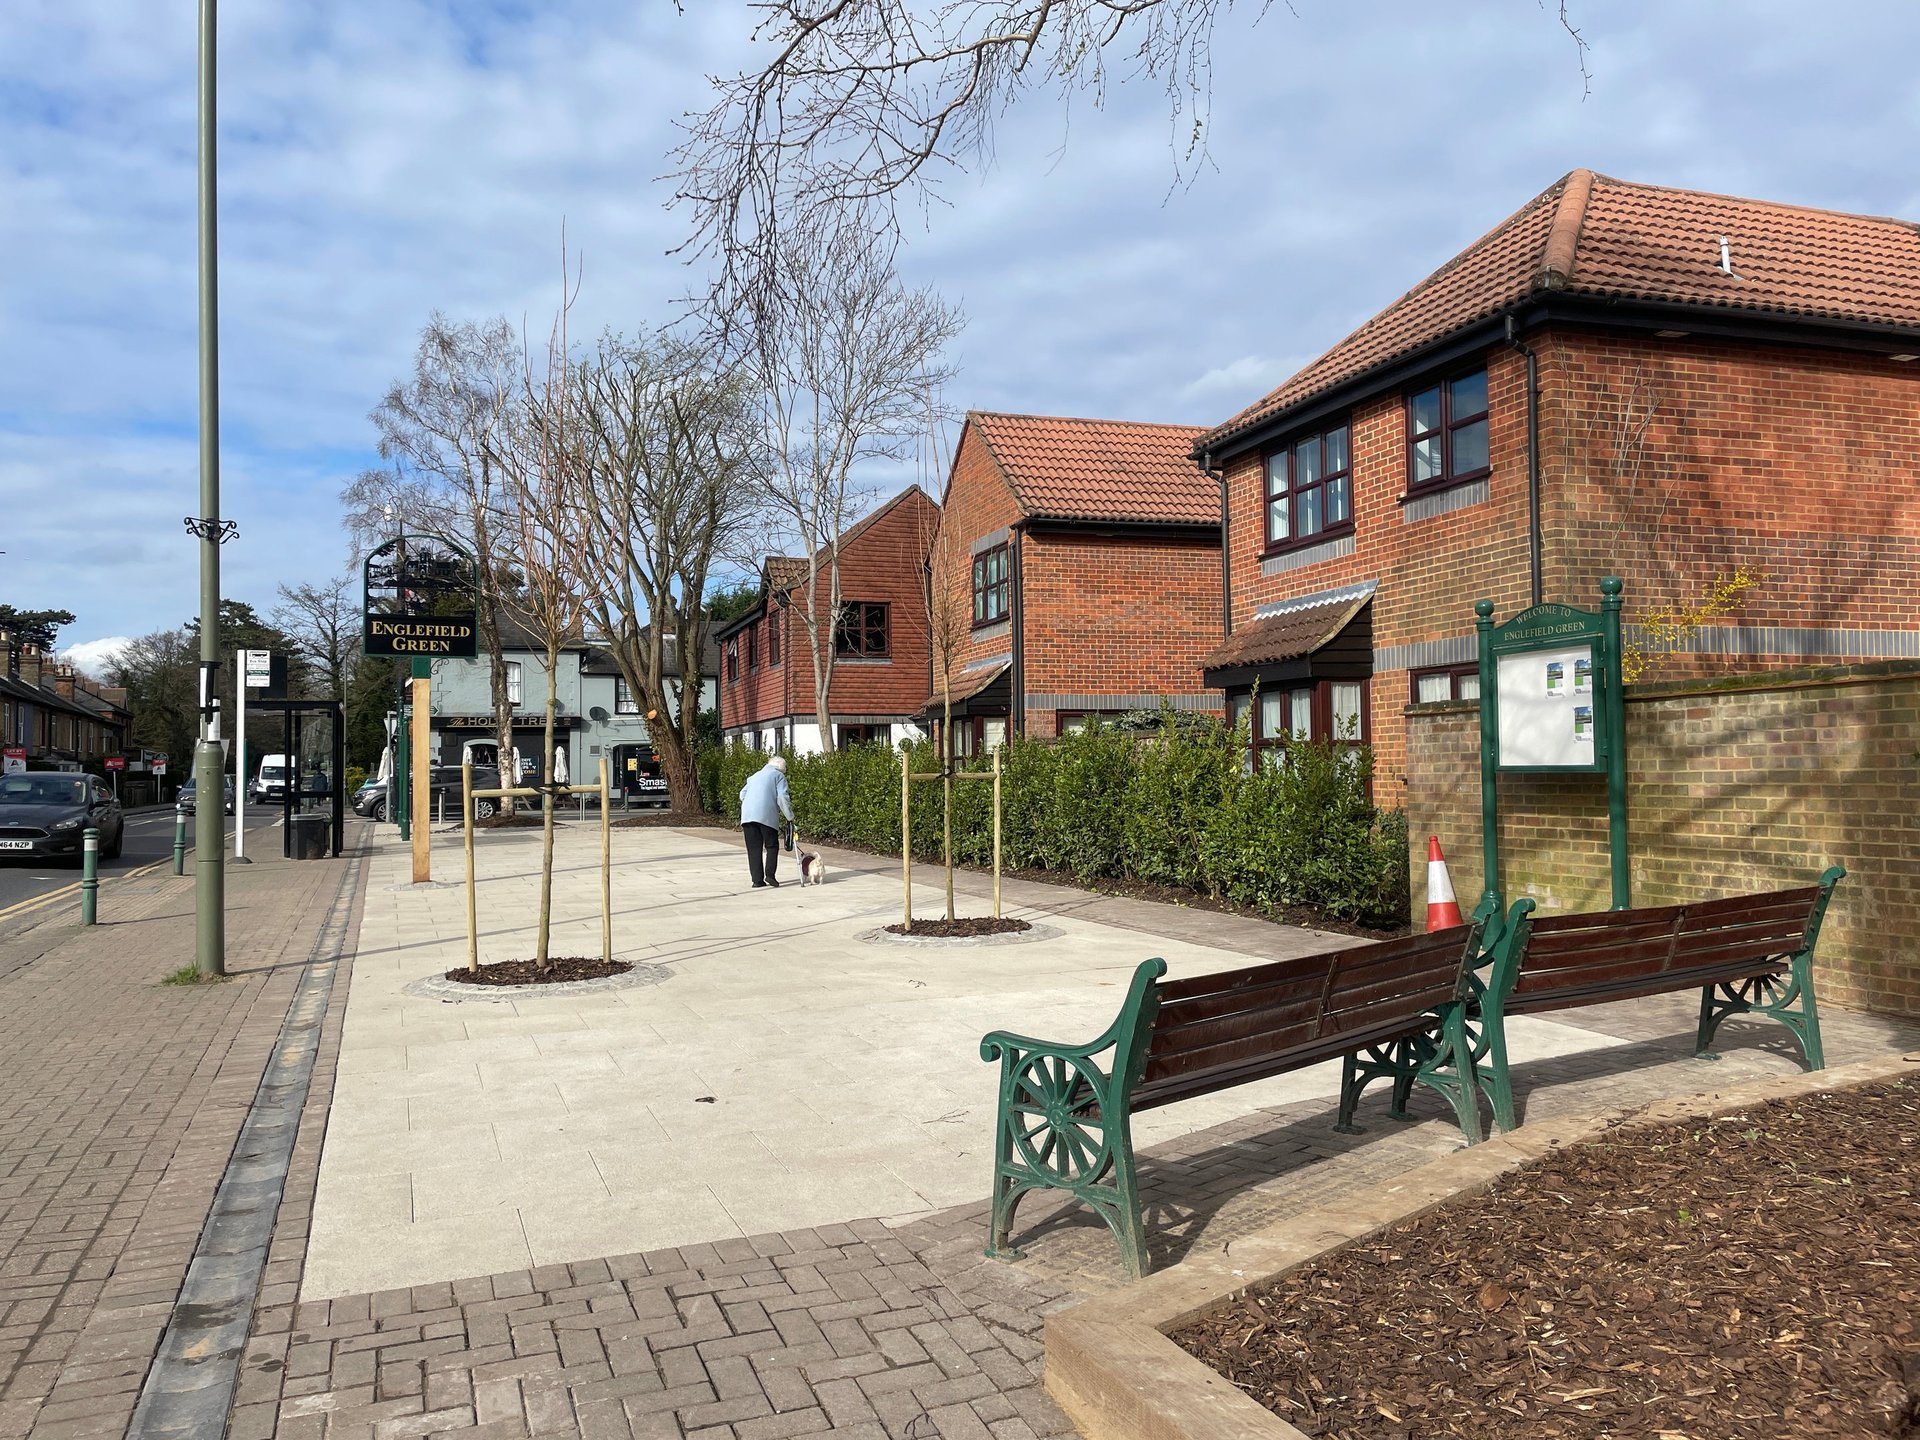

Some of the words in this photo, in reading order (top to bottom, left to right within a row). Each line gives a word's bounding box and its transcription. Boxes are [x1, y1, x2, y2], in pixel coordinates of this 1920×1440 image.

[1515, 605, 1557, 625] WELCOME
[1560, 606, 1571, 617] TO
[370, 620, 471, 637] ENGLEFIELD
[1504, 625, 1554, 641] ENGLEFIELD
[1555, 621, 1585, 634] GREEN
[392, 636, 451, 652] GREEN
[14, 841, 30, 849] NZP
